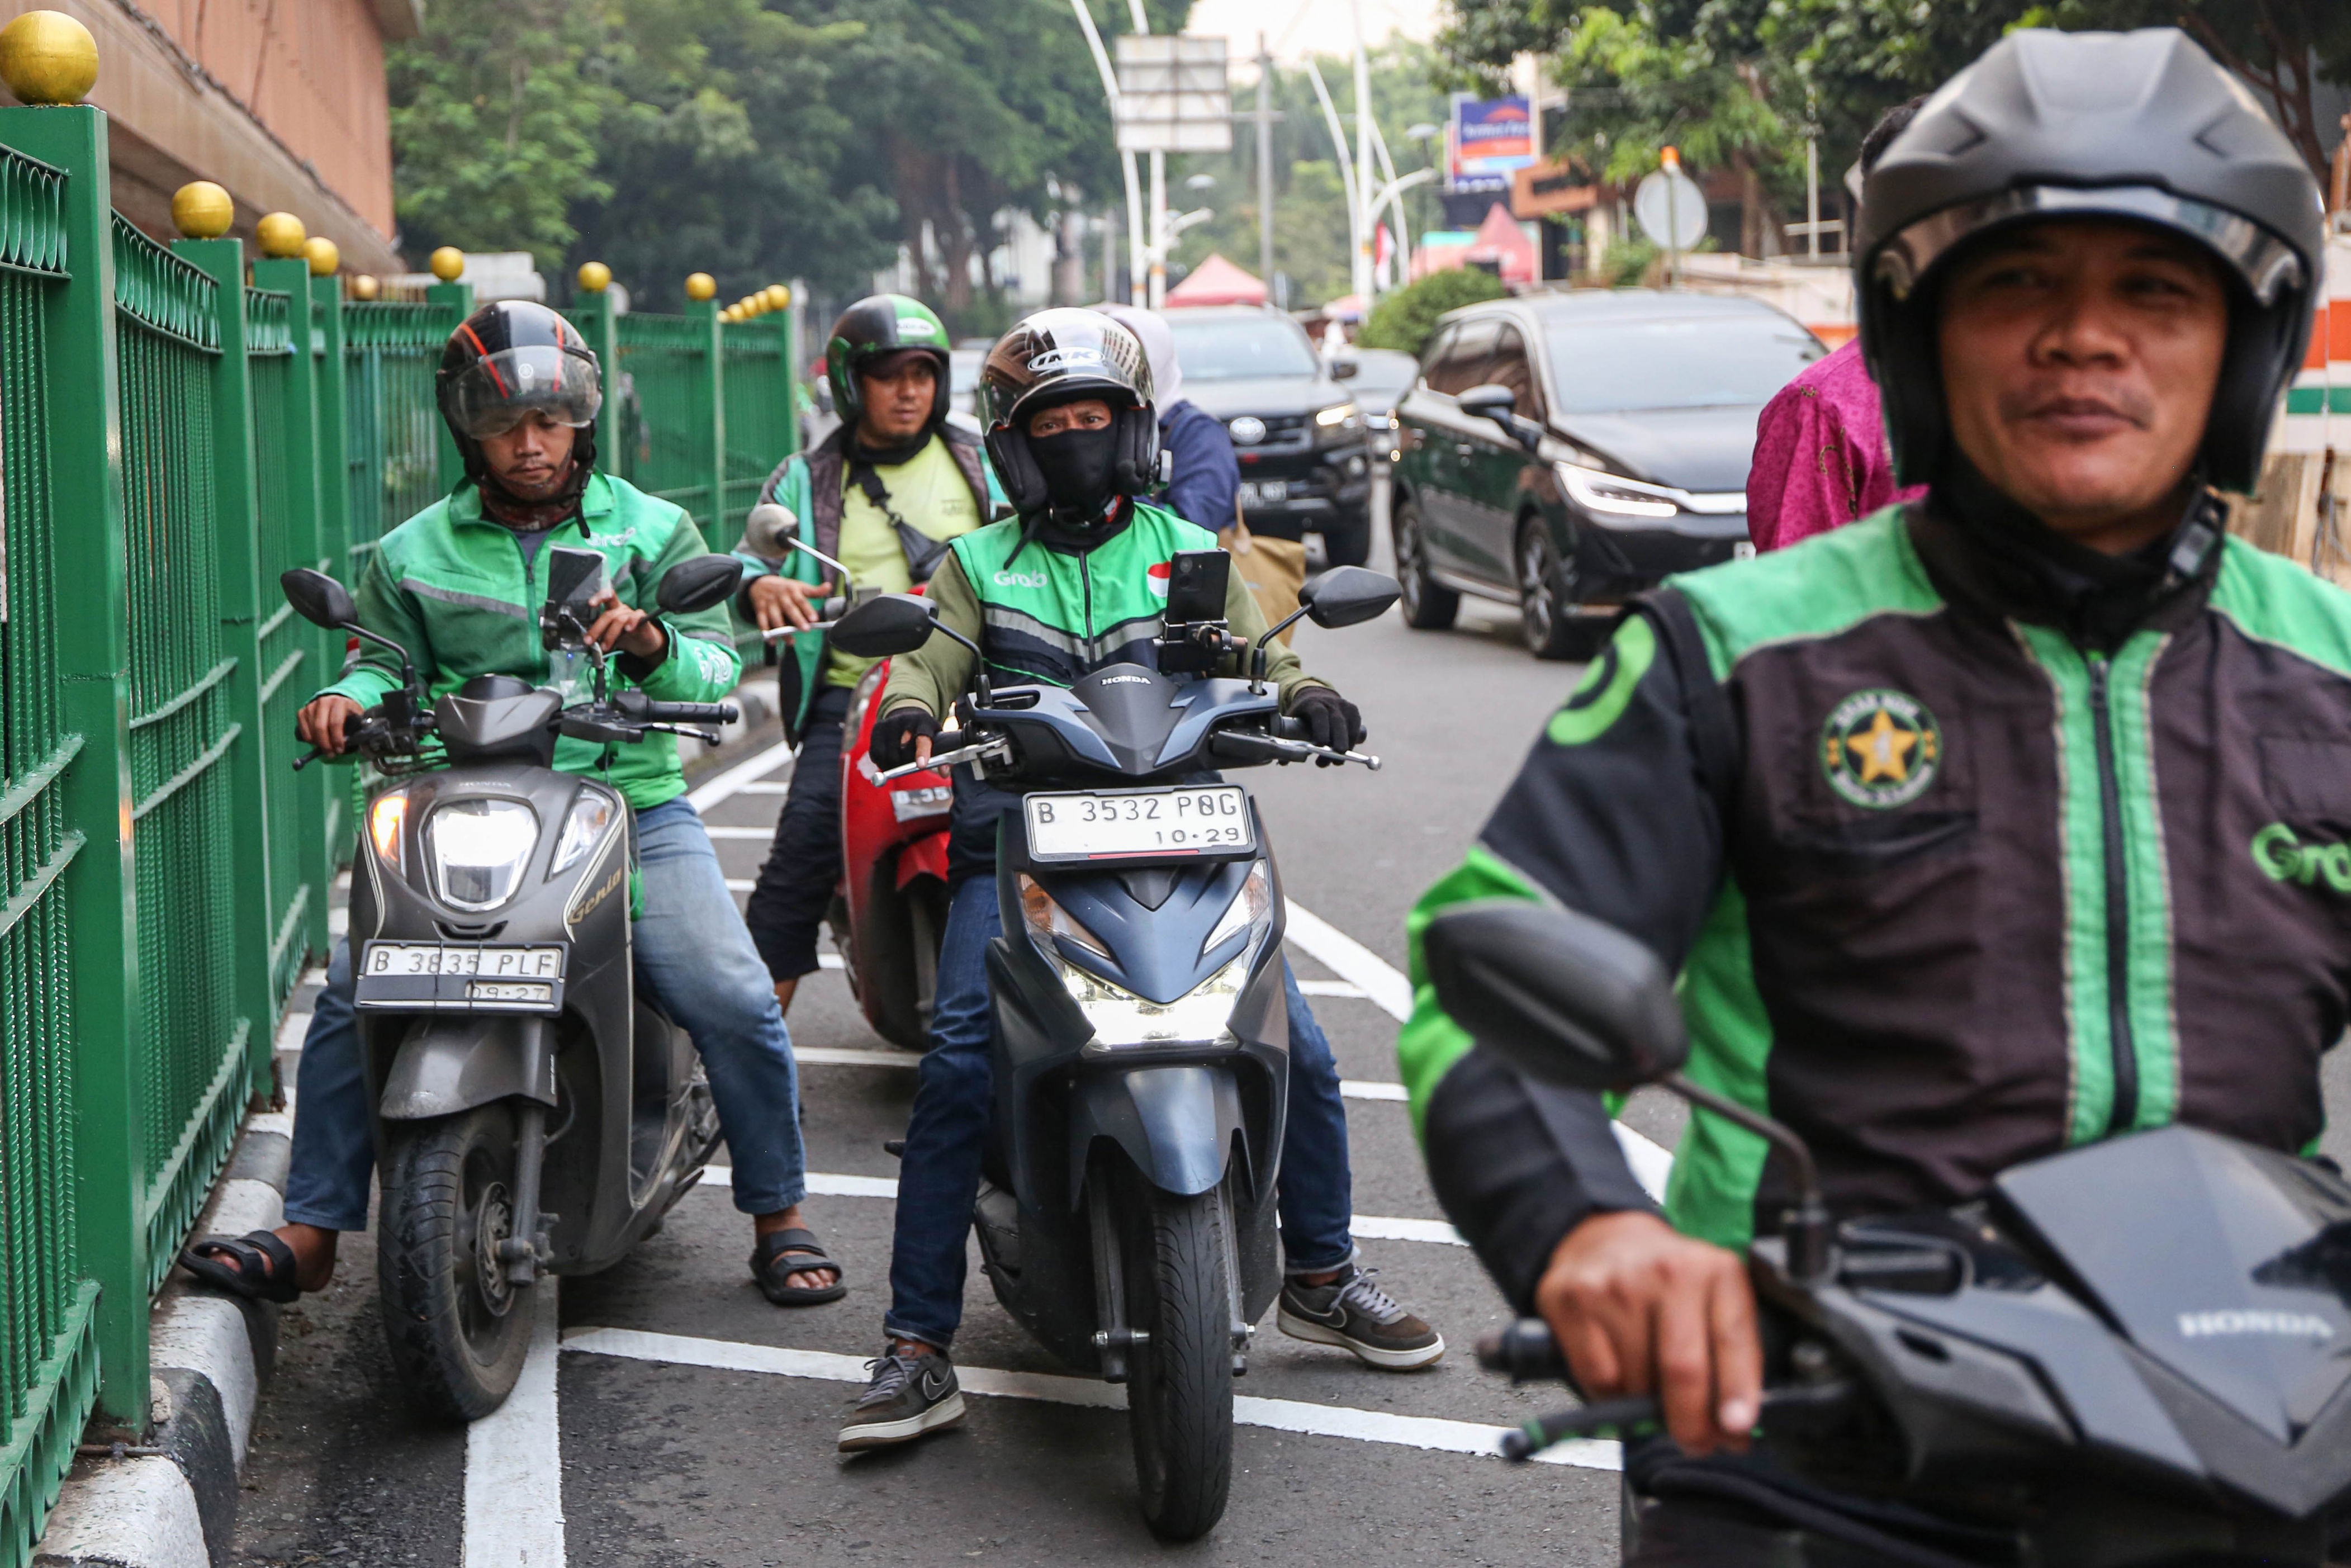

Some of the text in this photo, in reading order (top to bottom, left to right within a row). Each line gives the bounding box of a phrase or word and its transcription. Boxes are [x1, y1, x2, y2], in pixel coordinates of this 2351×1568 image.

[994, 570, 1048, 588] Grab
[1101, 675, 1152, 685] HONDA
[1039, 803, 1055, 824] B
[1081, 798, 1162, 821] 3532
[375, 950, 553, 976] B 3835 PLF
[2178, 1310, 2334, 1337] HONDA
